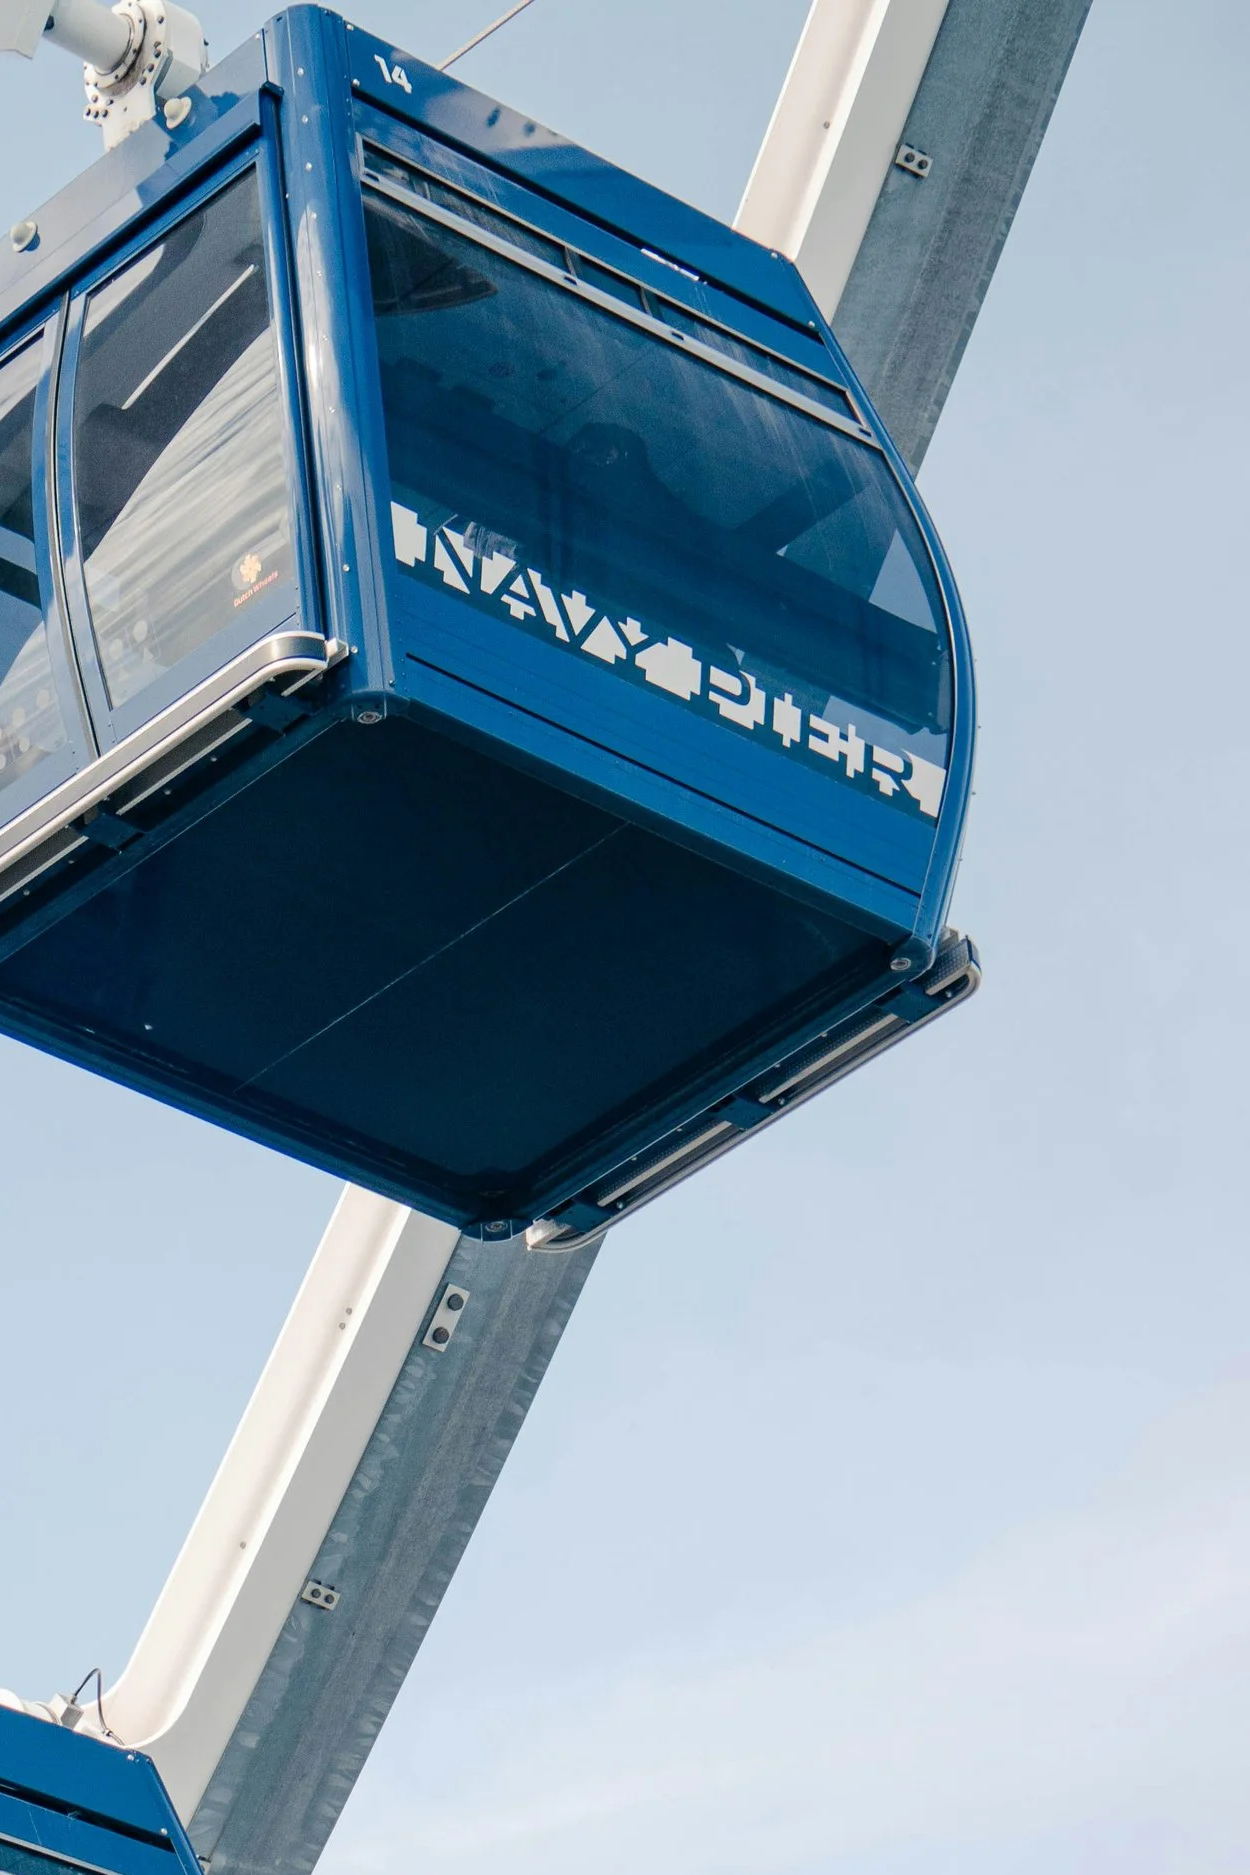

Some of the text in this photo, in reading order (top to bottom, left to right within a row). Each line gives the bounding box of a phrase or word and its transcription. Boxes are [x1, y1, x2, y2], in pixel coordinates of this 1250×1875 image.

[374, 54, 412, 94] 14
[412, 512, 921, 812] NAVY PIER
